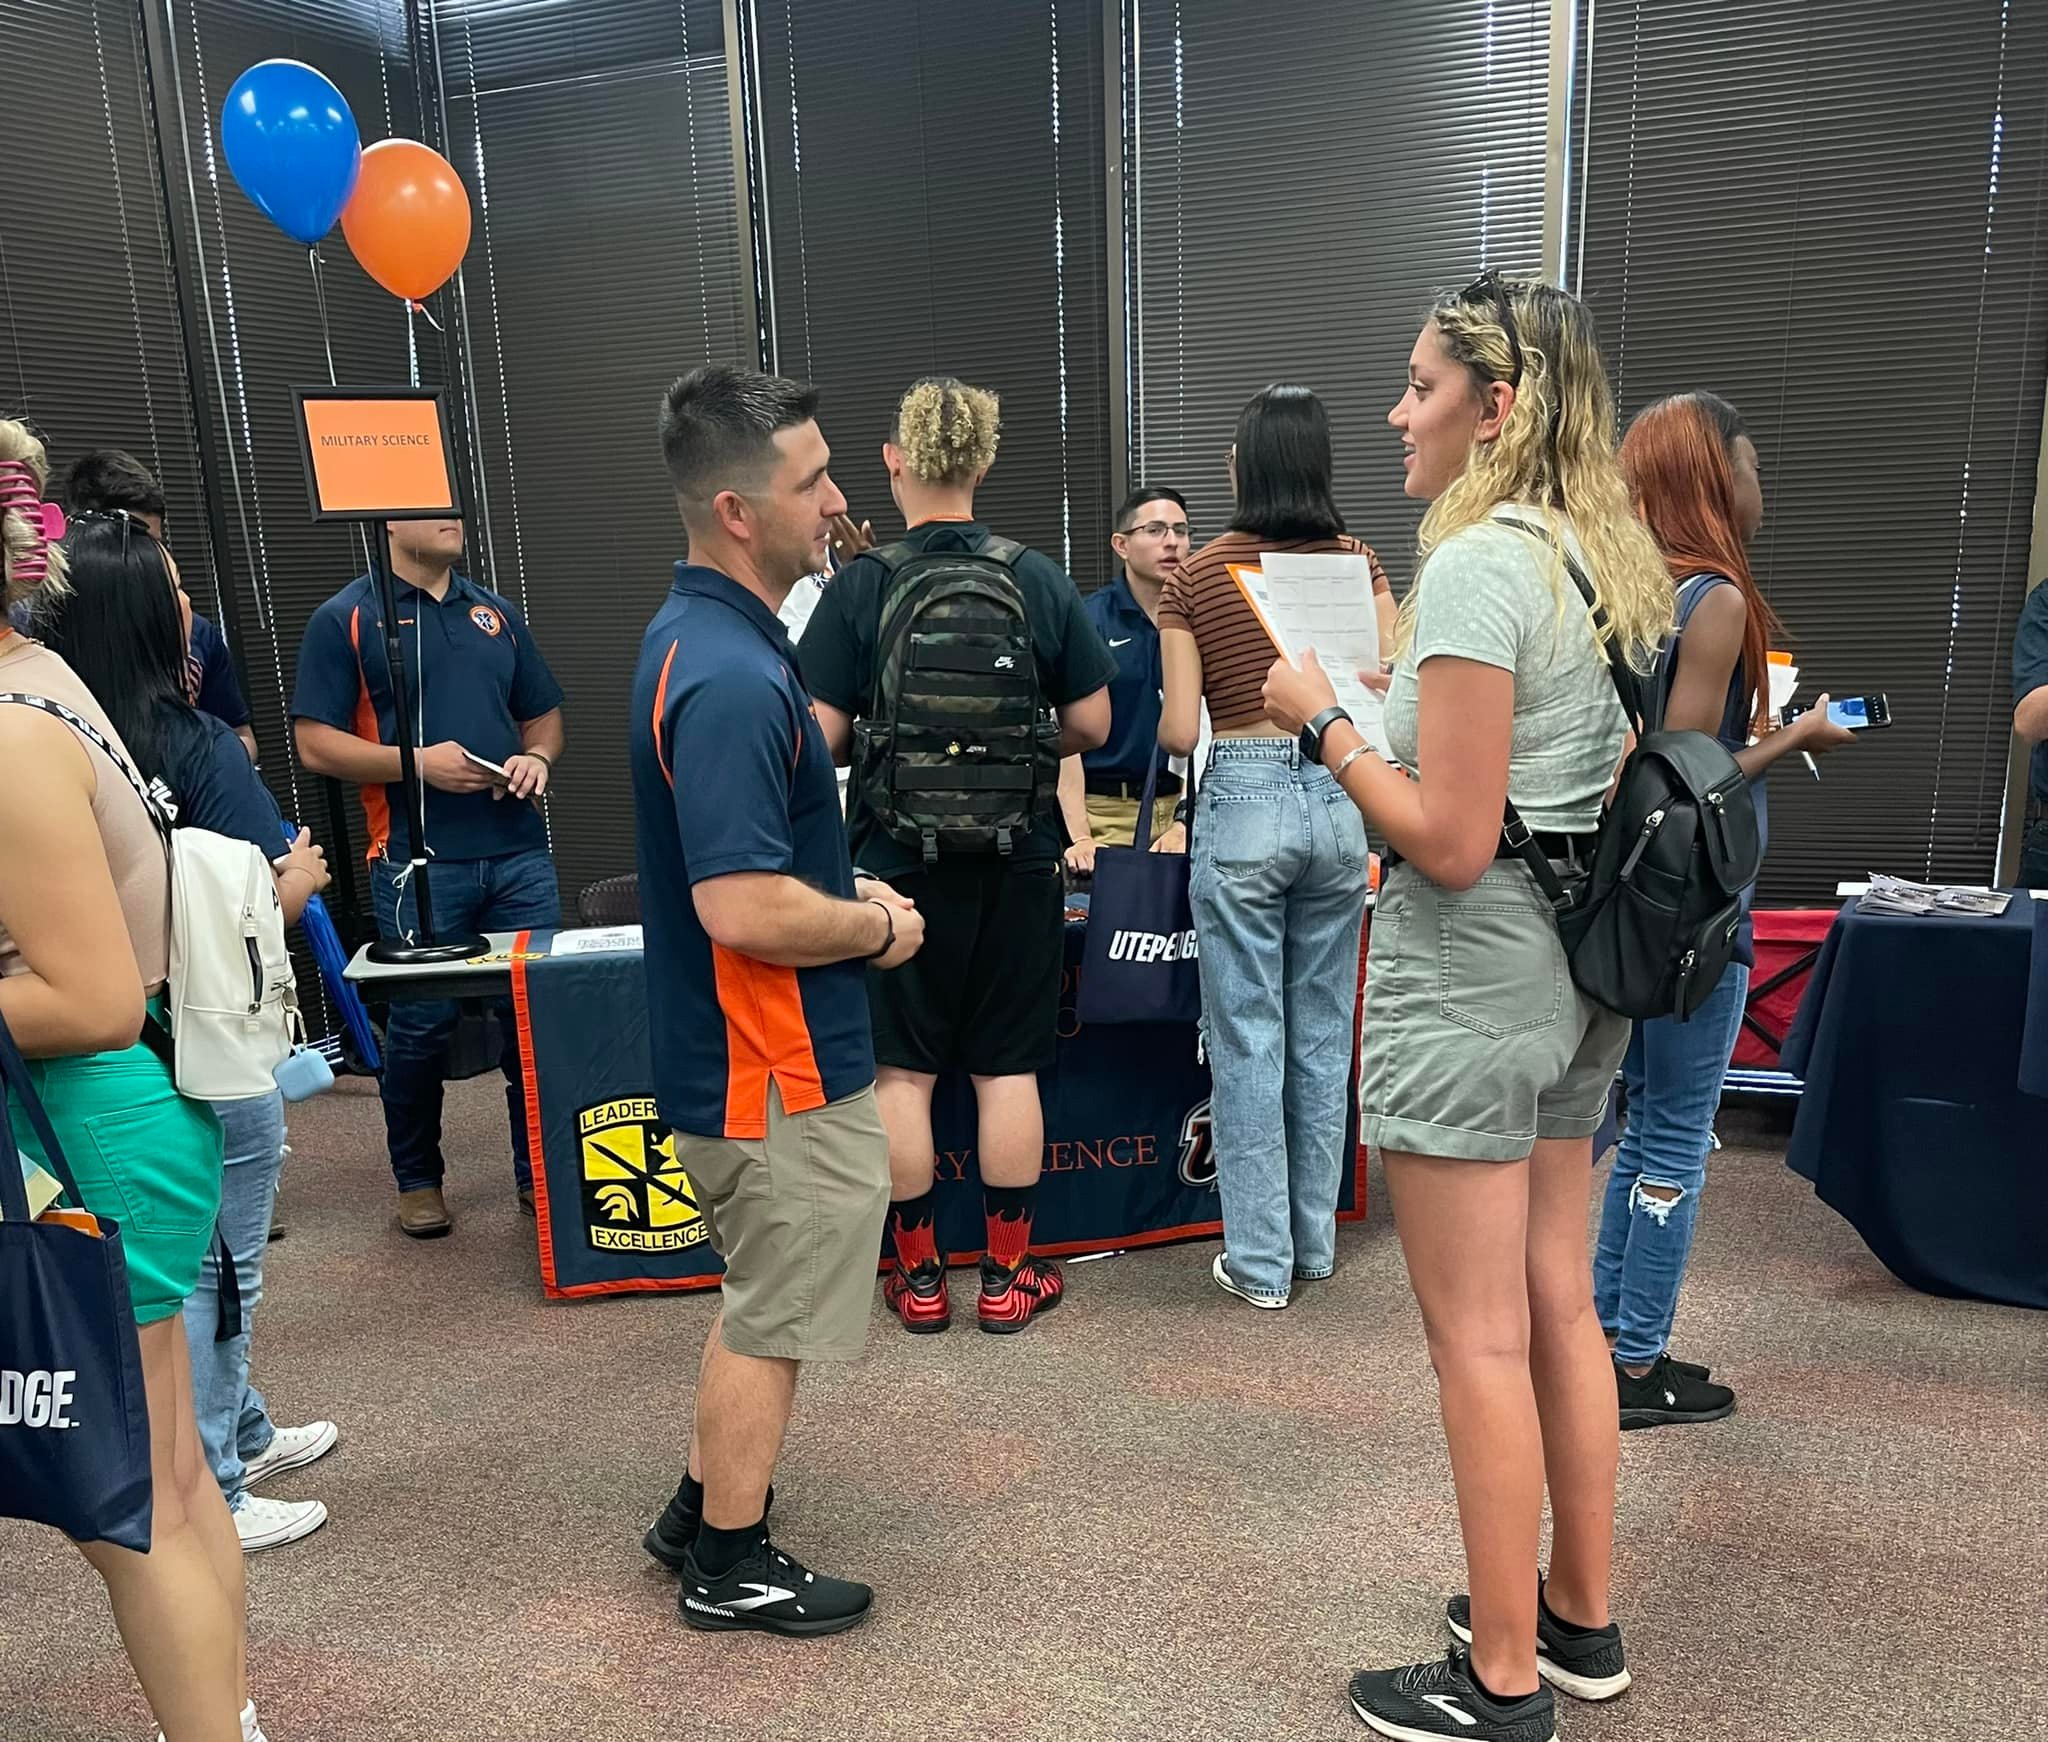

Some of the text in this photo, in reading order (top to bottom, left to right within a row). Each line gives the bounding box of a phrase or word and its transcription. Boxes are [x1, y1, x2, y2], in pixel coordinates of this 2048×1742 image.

[320, 434, 430, 447] MILITARY SCIENCE
[149, 776, 178, 821] FILA
[595, 1225, 709, 1248] EXCELLENCE
